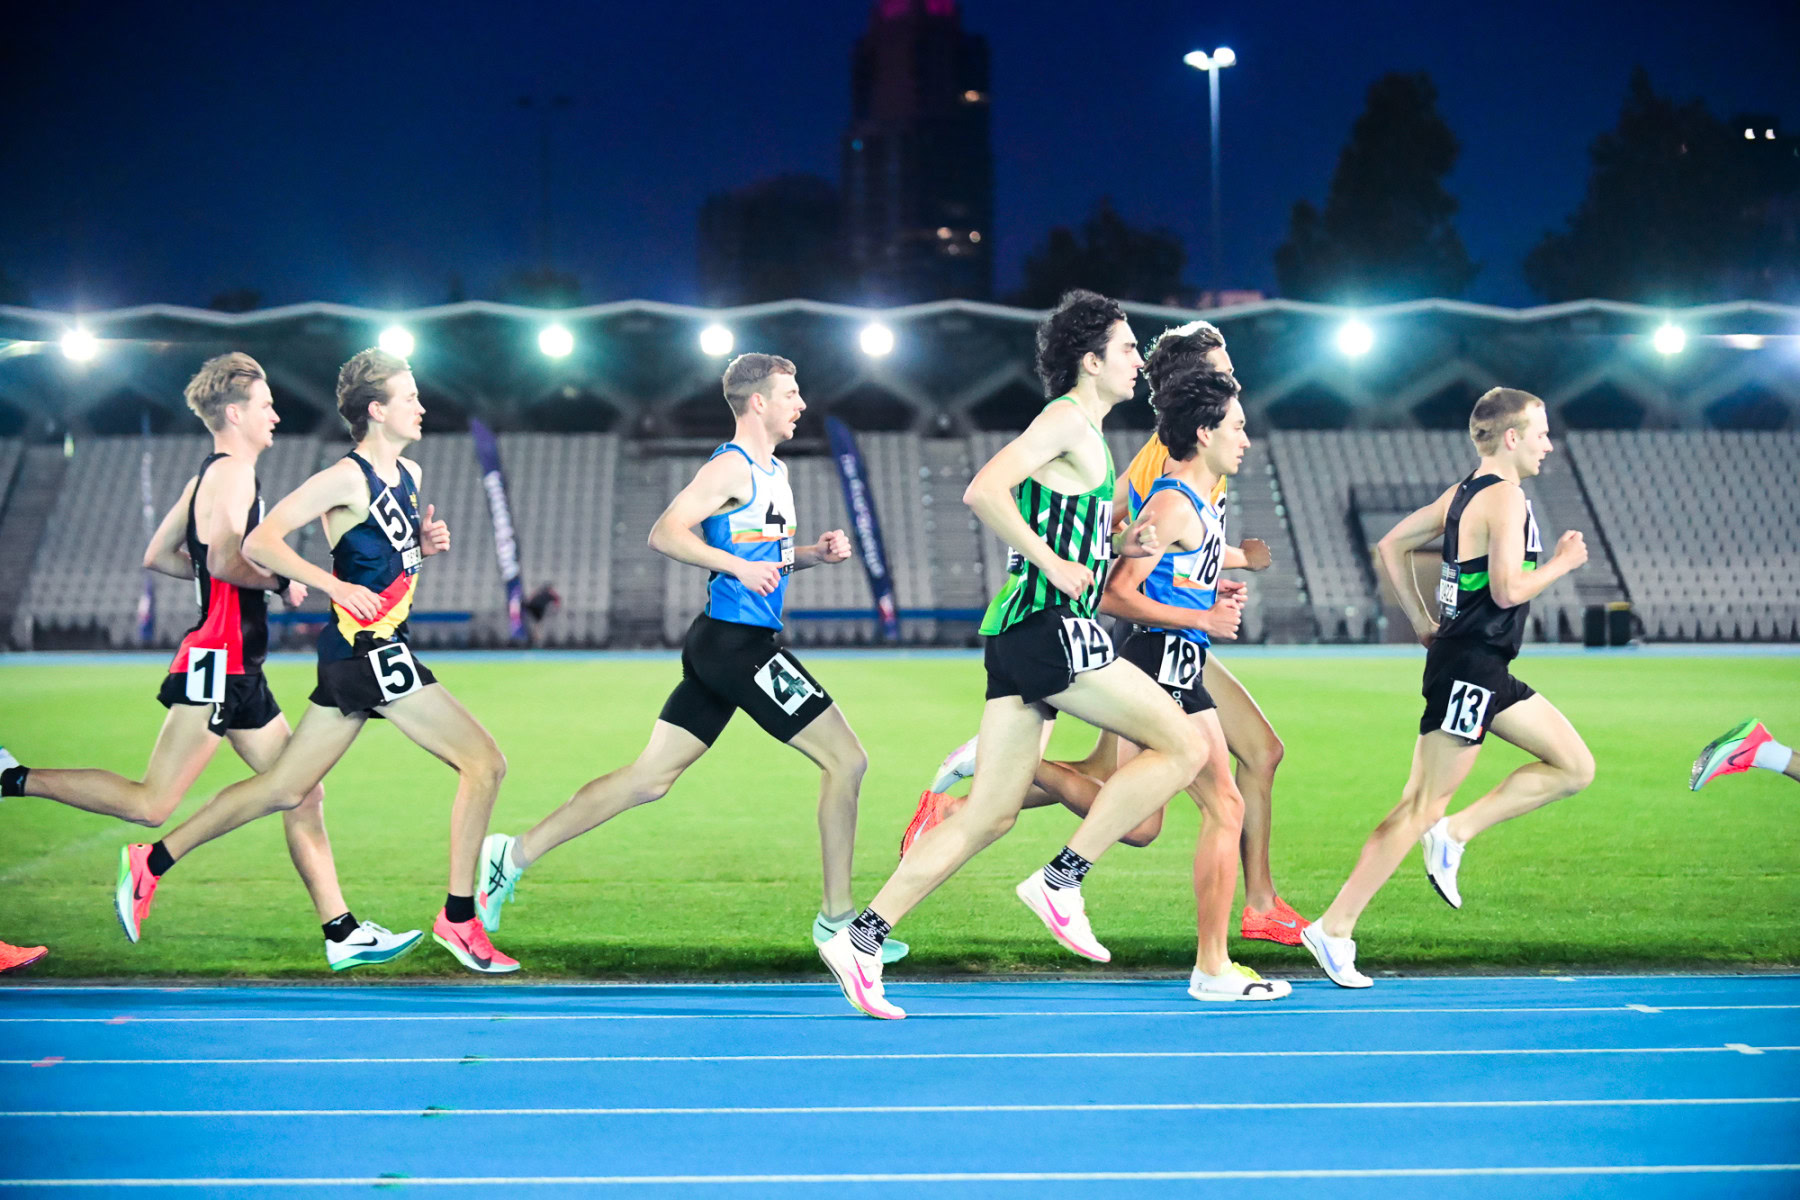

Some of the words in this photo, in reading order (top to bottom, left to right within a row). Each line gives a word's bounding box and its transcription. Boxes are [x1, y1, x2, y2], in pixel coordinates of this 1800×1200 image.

[376, 496, 407, 542] 5
[765, 501, 787, 534] 4
[1197, 533, 1220, 585] 18
[1072, 620, 1110, 668] 14
[1166, 636, 1197, 685] 18
[194, 651, 215, 699] 1
[377, 645, 414, 695] 5
[768, 659, 809, 706] 4
[1450, 684, 1483, 733] 13
